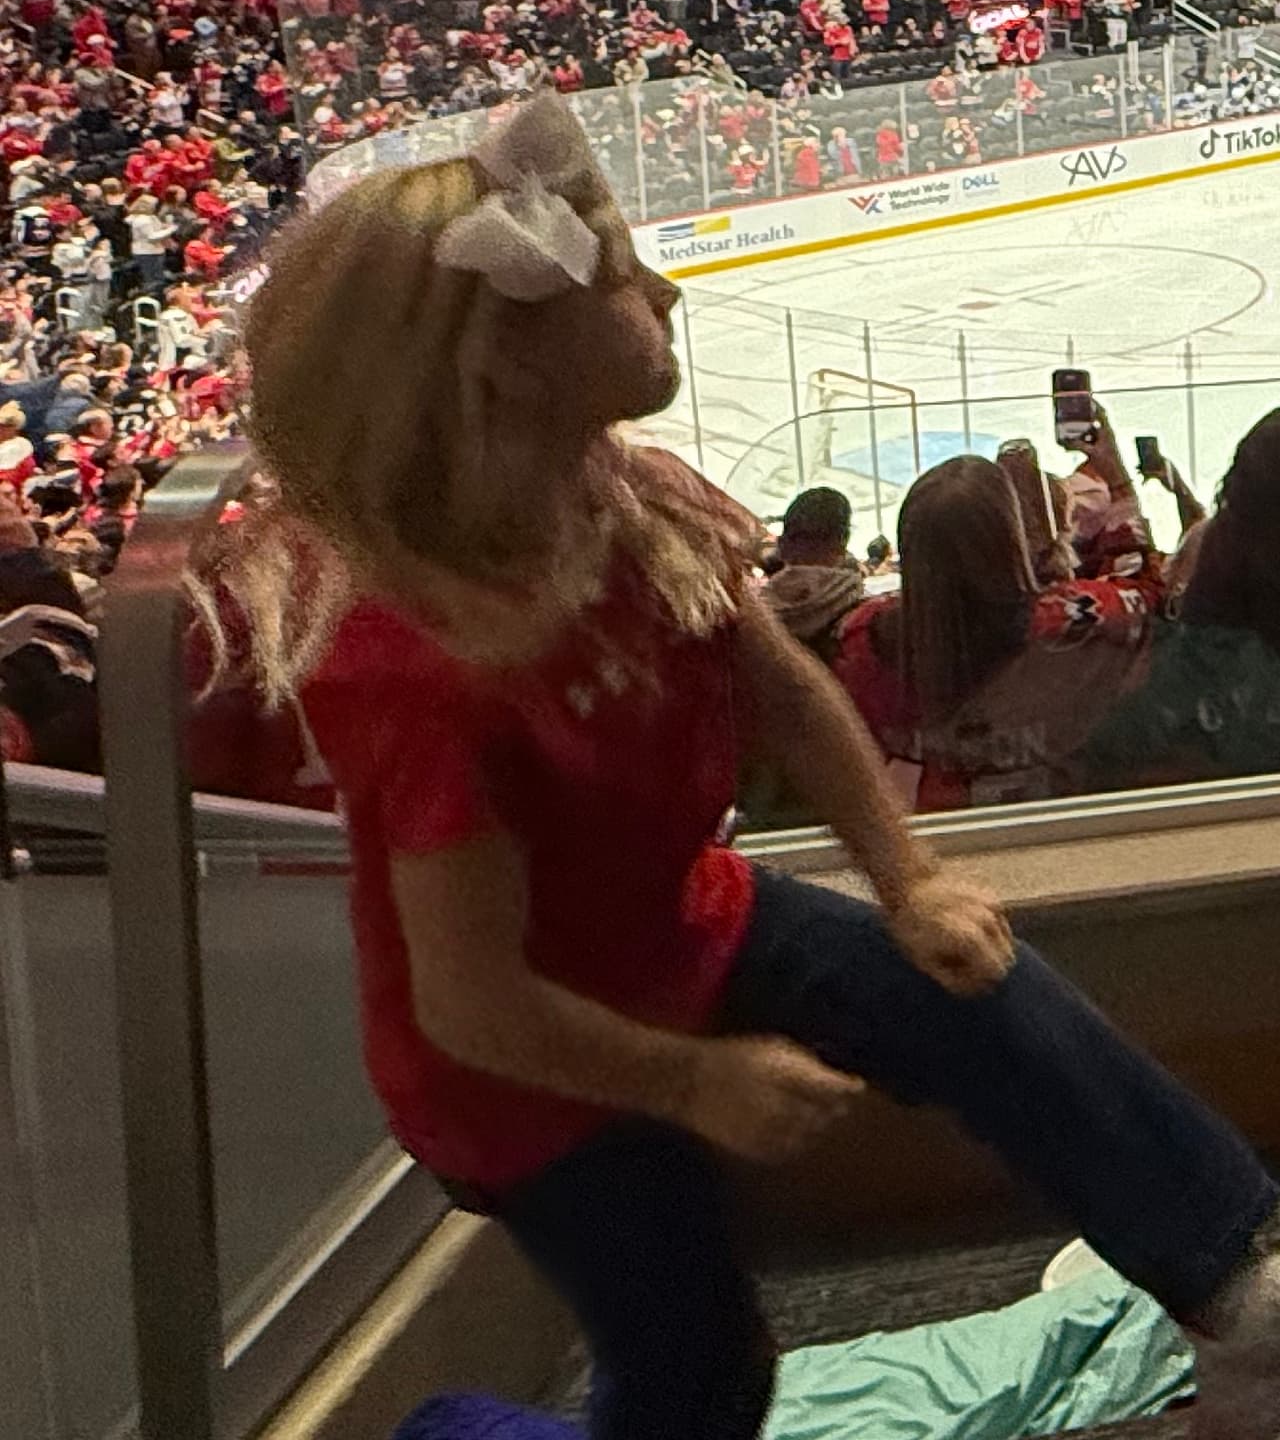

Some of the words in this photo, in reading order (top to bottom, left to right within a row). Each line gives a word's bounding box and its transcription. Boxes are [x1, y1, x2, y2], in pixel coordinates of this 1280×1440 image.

[888, 184, 920, 201] World
[659, 238, 731, 264] MedStar
[736, 223, 796, 249] Health
